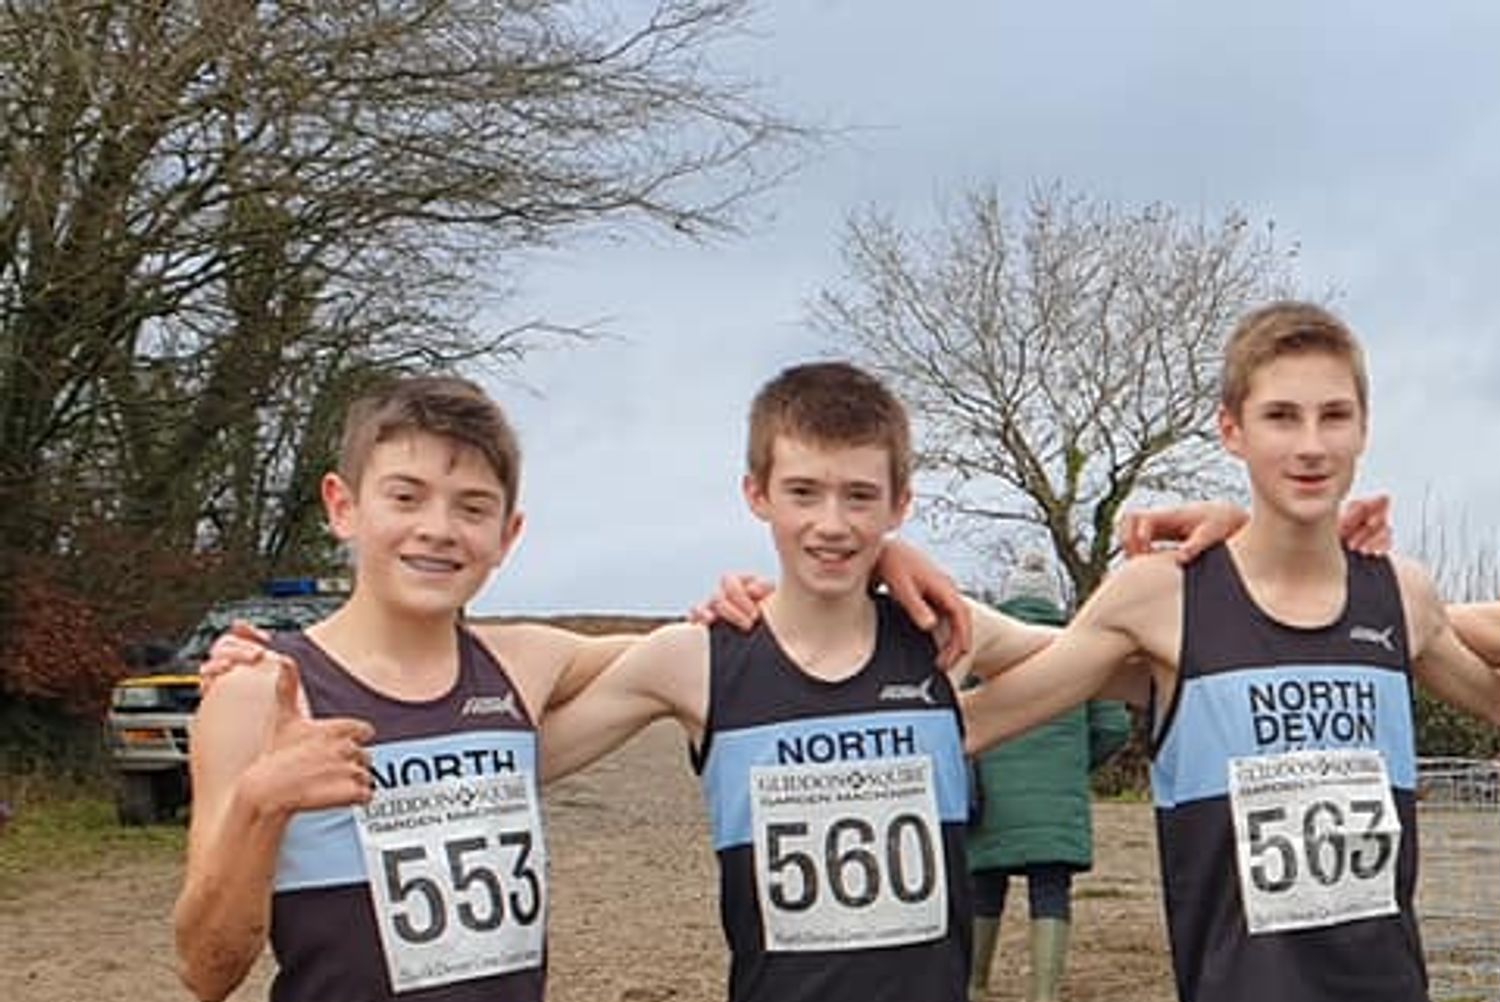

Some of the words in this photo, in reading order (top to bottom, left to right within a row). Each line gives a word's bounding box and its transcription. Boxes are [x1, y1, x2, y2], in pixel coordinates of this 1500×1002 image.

[1249, 681, 1376, 711] NORTH
[776, 725, 915, 764] NORTH
[1253, 713, 1376, 745] DEVON
[369, 749, 516, 789] NORTH
[765, 814, 936, 912] 560
[1247, 801, 1391, 892] 563
[382, 831, 540, 944] 553
